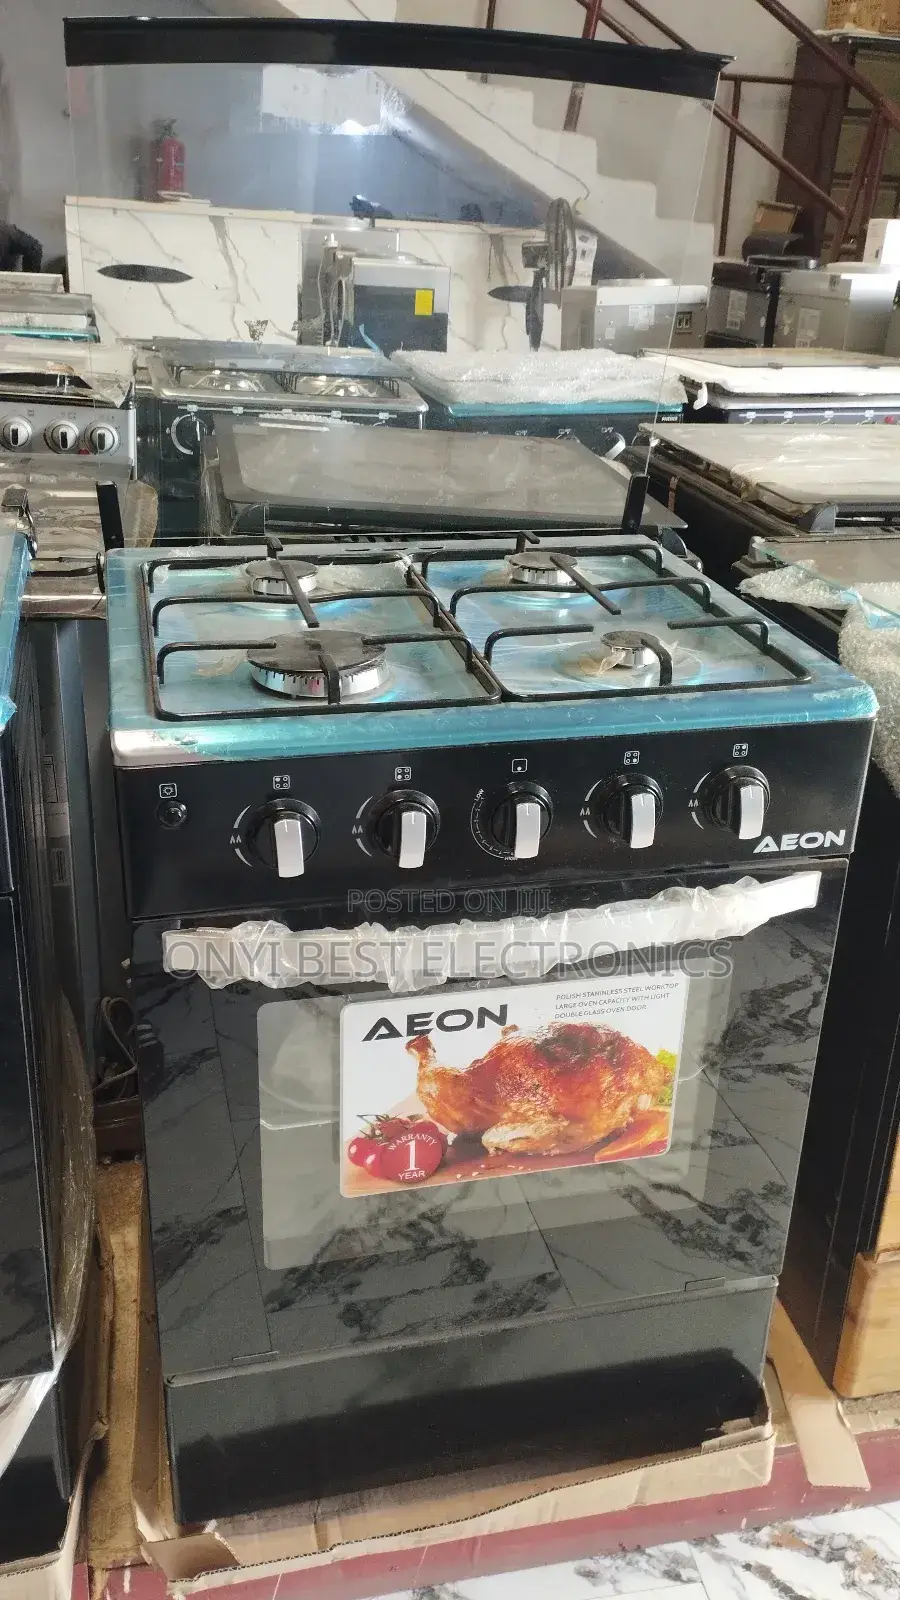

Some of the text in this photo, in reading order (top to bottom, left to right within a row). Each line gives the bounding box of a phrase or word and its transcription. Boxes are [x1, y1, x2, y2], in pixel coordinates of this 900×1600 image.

[753, 830, 846, 854] AEON
[555, 1002, 577, 1010] LARGE
[577, 1001, 597, 1009] OVEN
[598, 997, 630, 1006] CAPACITY
[650, 992, 670, 1000] LIGHT
[556, 993, 581, 1001] POLISH
[645, 983, 679, 991] WORKTOP
[554, 1011, 583, 1019] DOUBLE
[605, 1006, 625, 1014] OVEN
[626, 1004, 647, 1012] DOOR
[362, 1004, 508, 1042] AEON
[388, 1133, 437, 1151] WARRANTY
[404, 1139, 420, 1171] 1
[398, 1170, 426, 1180] YEAR
